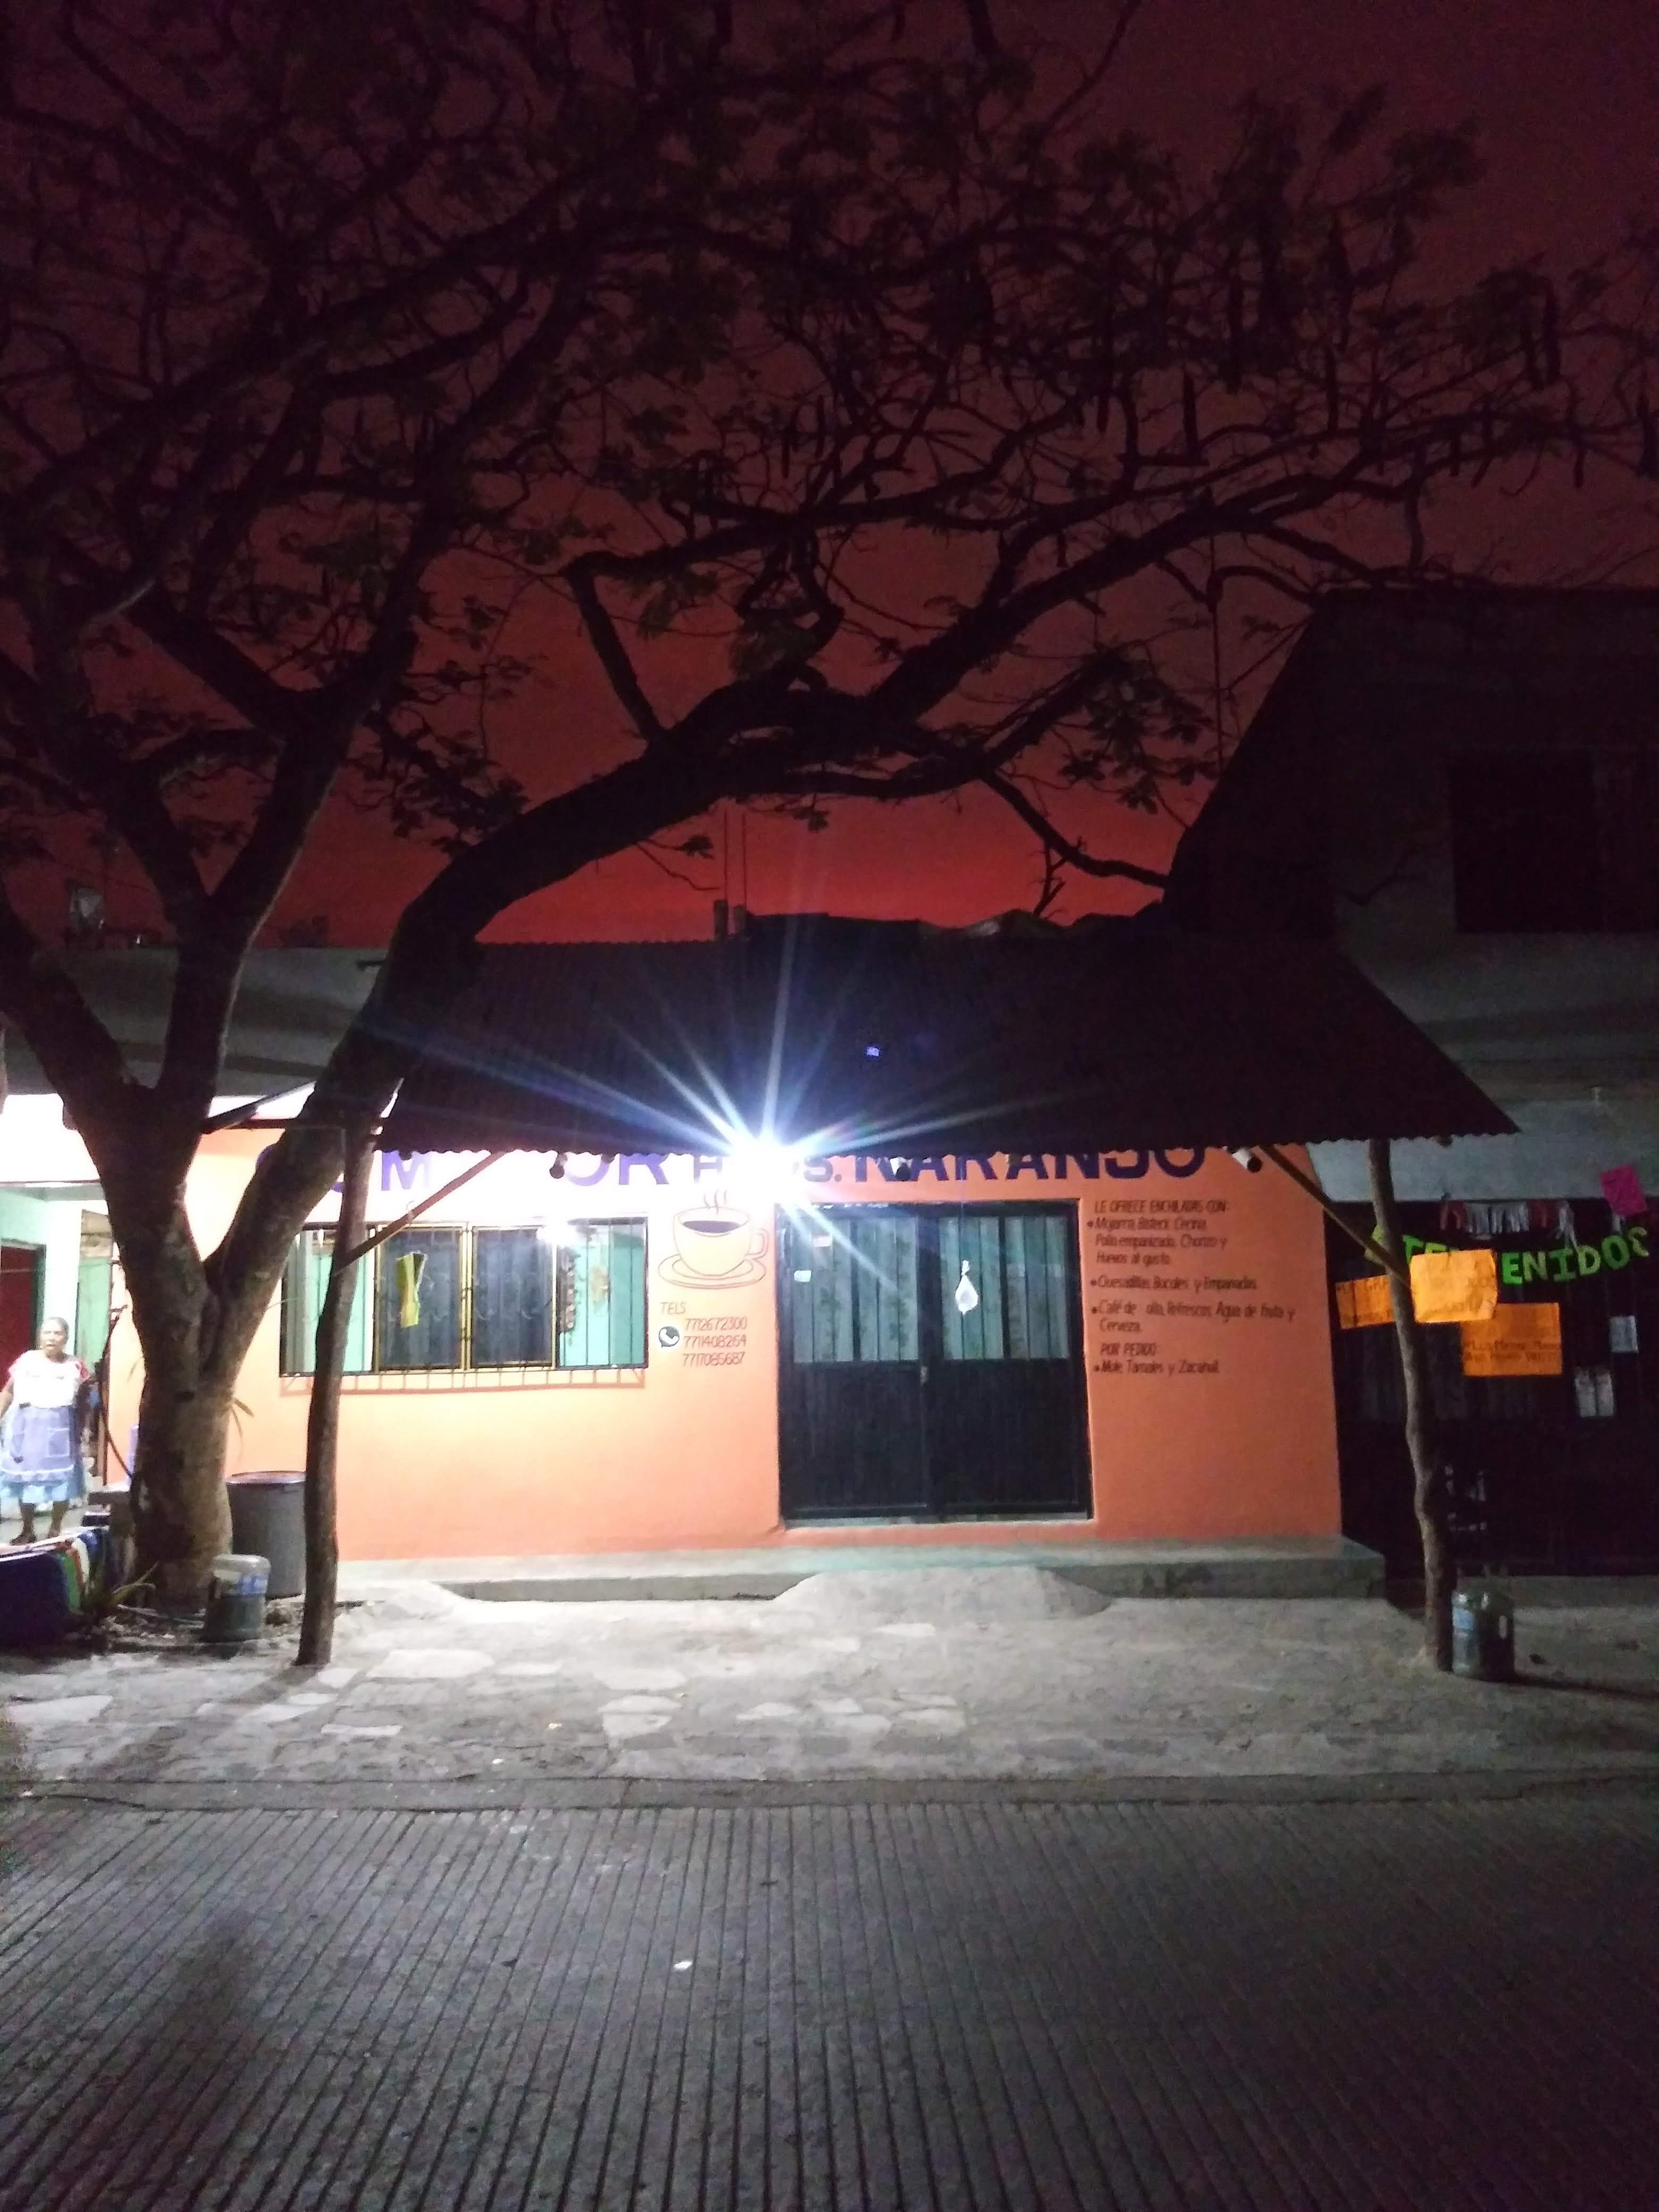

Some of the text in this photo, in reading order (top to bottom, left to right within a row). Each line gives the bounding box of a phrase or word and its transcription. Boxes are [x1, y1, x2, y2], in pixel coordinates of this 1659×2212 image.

[1094, 1200, 1107, 1213] LE
[1110, 1200, 1146, 1213] OFRECE
[1150, 1200, 1203, 1213] ENCHILADAS
[1220, 1237, 1228, 1250] y
[1096, 1251, 1127, 1264] Huevos
[1130, 1251, 1140, 1264] al
[1194, 1278, 1201, 1294] y
[1124, 1301, 1137, 1315] de
[1216, 1302, 1241, 1323] Agua
[1244, 1303, 1256, 1318] de
[1287, 1309, 1295, 1322] y
[1101, 1343, 1120, 1355] POR
[1168, 1363, 1175, 1376] y
